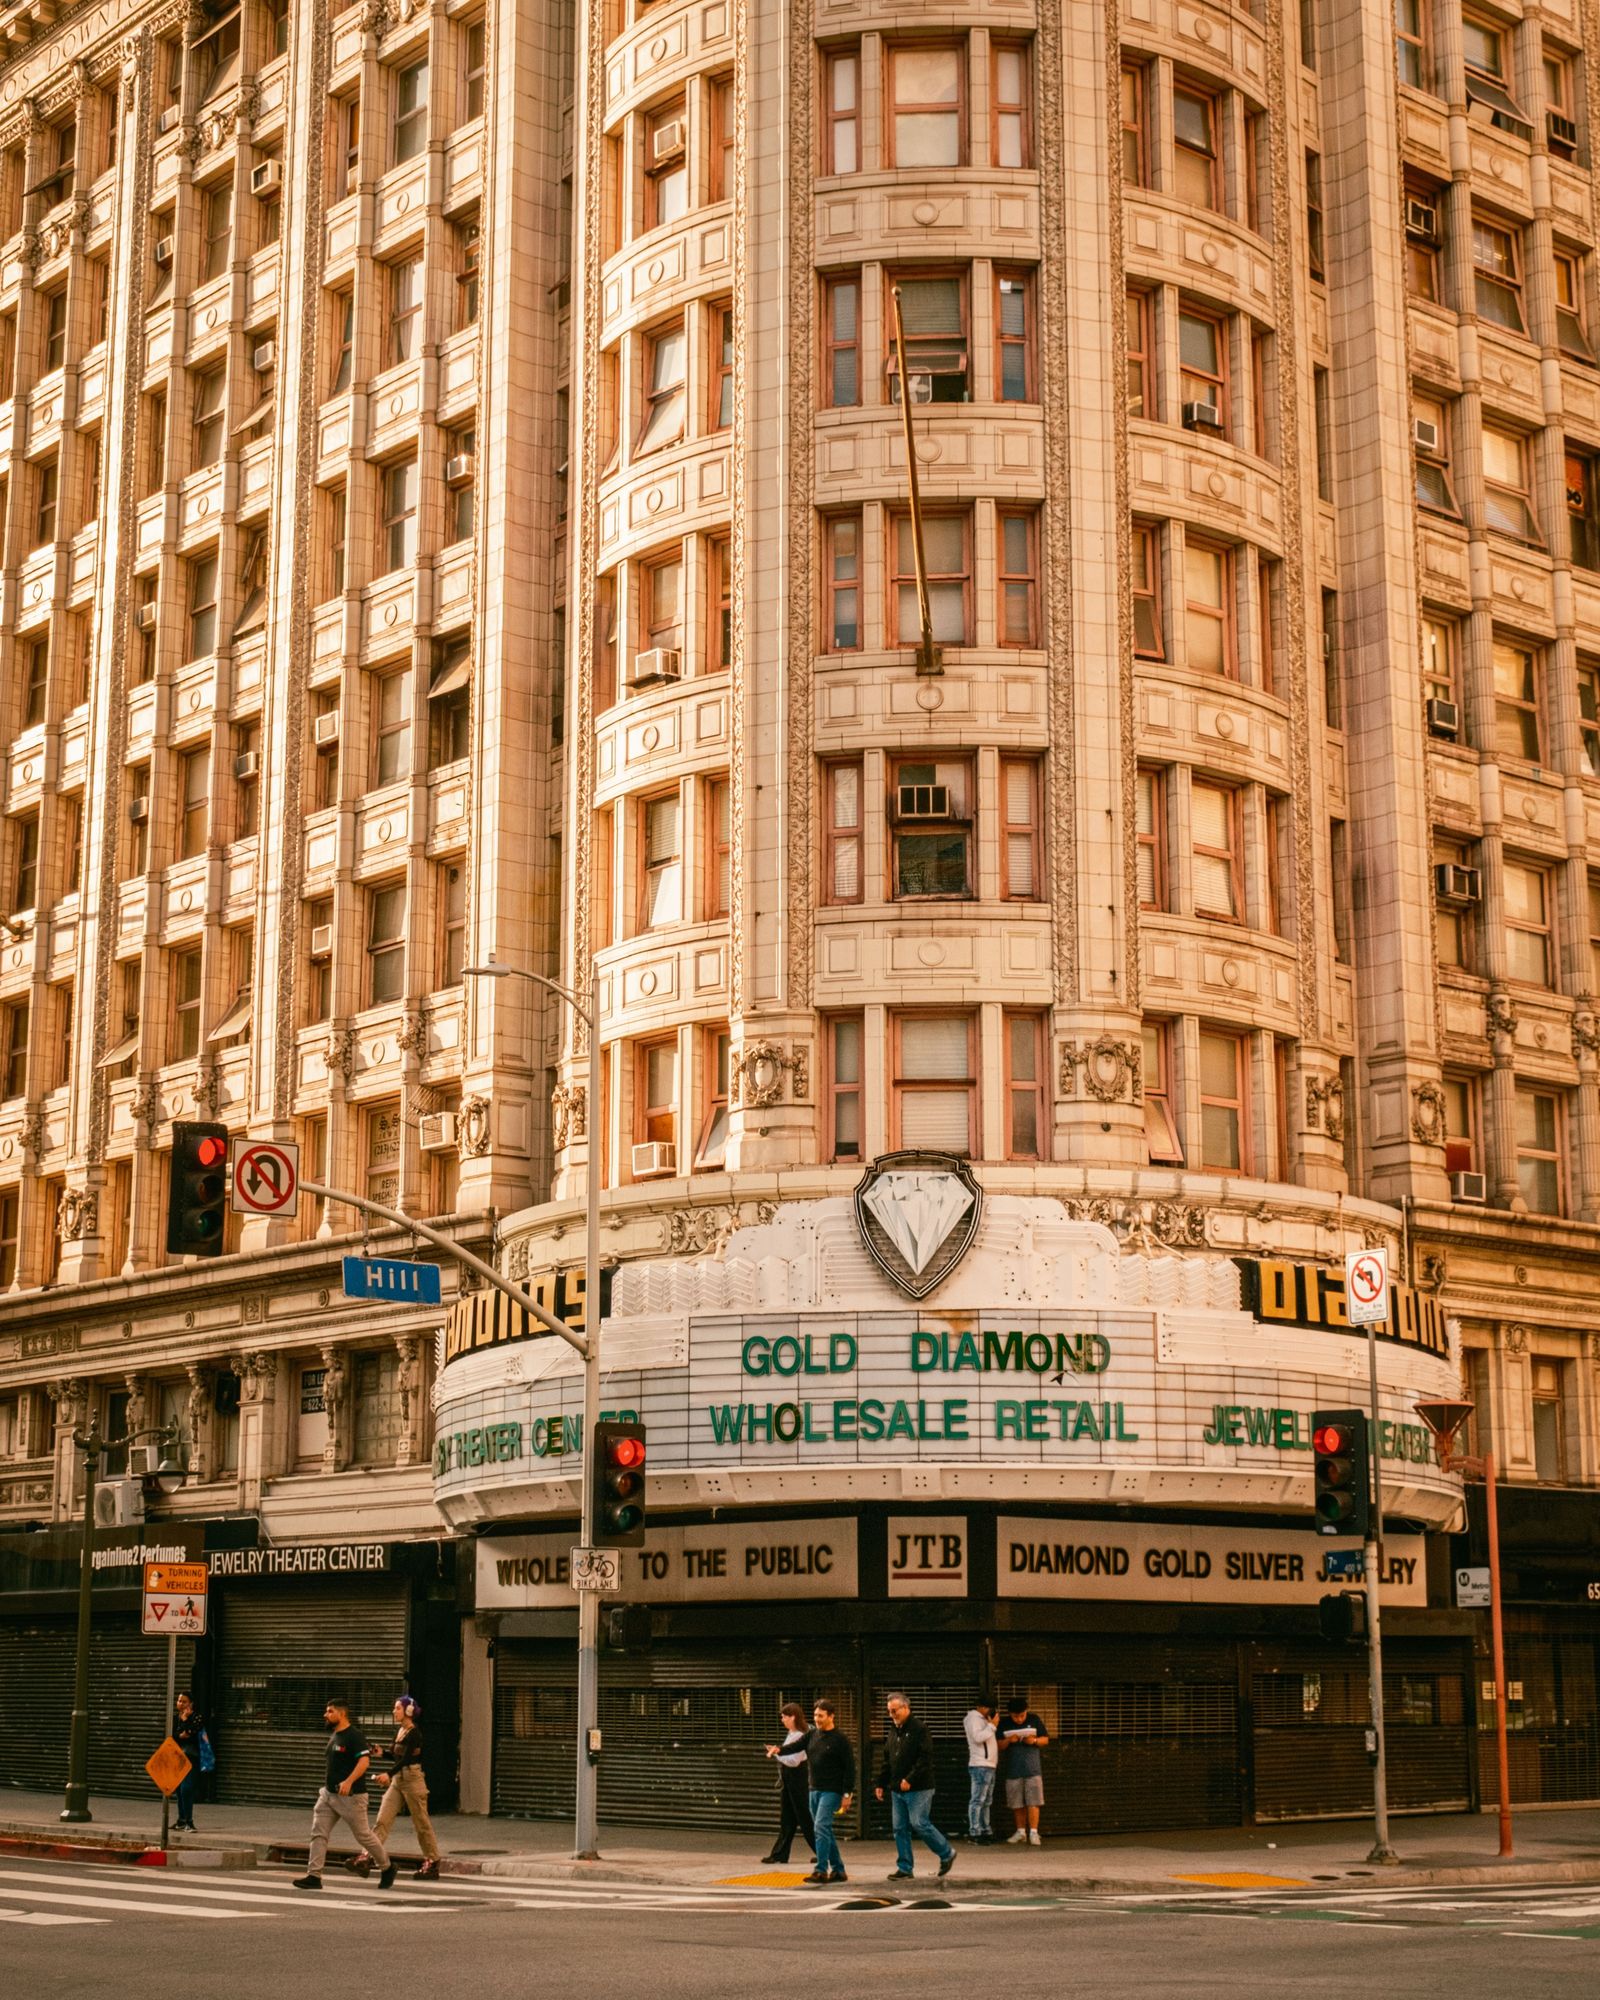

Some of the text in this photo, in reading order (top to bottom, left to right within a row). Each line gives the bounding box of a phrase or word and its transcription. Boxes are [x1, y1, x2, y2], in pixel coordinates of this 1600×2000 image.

[367, 1265, 418, 1291] Hill
[742, 1331, 1111, 1377] GOLD DIAMOND
[709, 1398, 1139, 1445] WHOLESALE RETAIL
[454, 1421, 523, 1469] THEATER
[140, 1544, 186, 1564] Perfumes
[208, 1544, 384, 1575] JEWELRY THEATER CENTER
[638, 1553, 669, 1579] TO
[683, 1549, 727, 1577] THE
[745, 1544, 833, 1576] PUBLIC
[893, 1535, 962, 1569] JTB
[1010, 1542, 1129, 1575] DIAMOND
[1144, 1549, 1211, 1579] GOLD
[1225, 1552, 1304, 1581] SILVER
[166, 1580, 204, 1591] VEHICLES
[168, 1567, 203, 1578] TURNING
[1471, 1582, 1490, 1590] Metro
